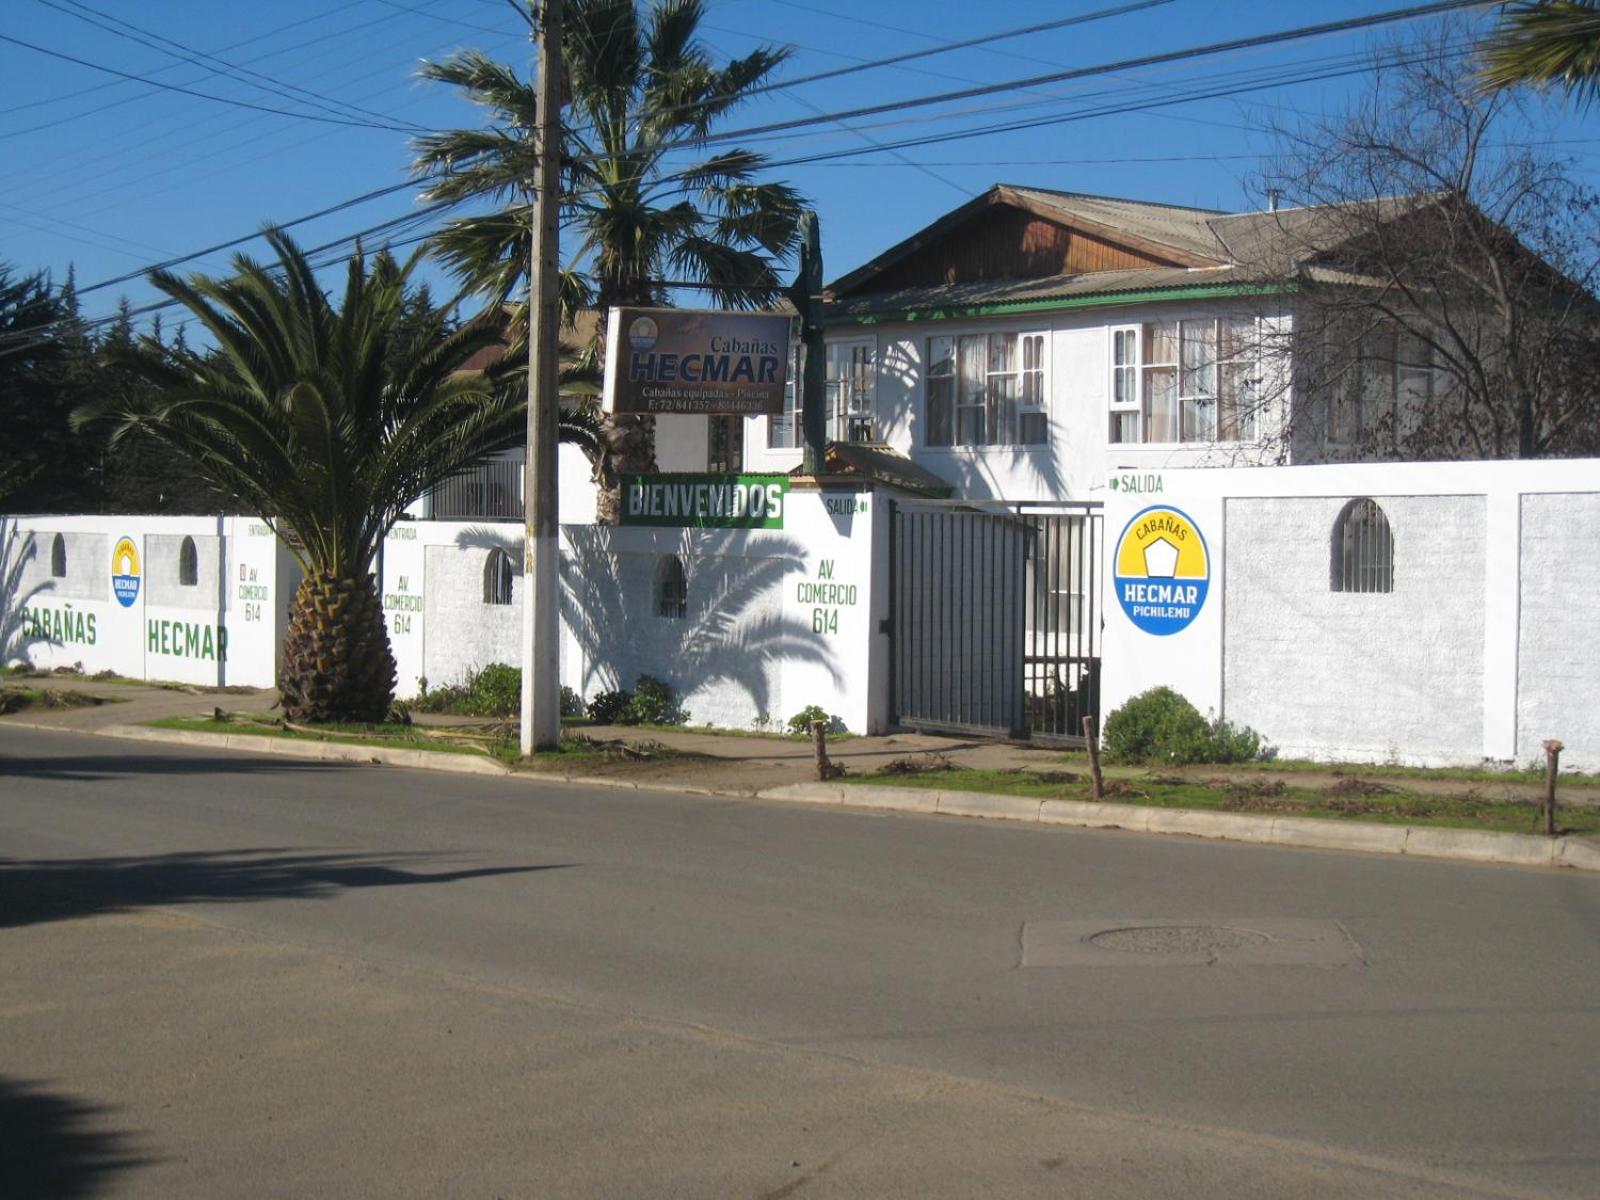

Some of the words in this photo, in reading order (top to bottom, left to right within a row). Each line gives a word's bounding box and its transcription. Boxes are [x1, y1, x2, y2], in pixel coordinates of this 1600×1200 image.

[710, 335, 778, 354] Cabañas
[628, 351, 779, 384] HECMAR
[1121, 474, 1163, 493] SALIDA
[629, 483, 782, 518] BIENVENIDOS
[826, 498, 858, 515] SALIDA
[1135, 516, 1188, 541] CABAÑAS
[384, 594, 422, 612] COMERCIO
[797, 582, 857, 605] COMERCIO
[1124, 584, 1198, 604] HECMAR
[245, 602, 261, 621] 614
[812, 607, 838, 634] 614
[1133, 606, 1190, 618] PICHILEMU
[22, 603, 97, 645] CABAÑAS
[148, 618, 228, 663] HECMAR
[394, 613, 411, 634] 614
